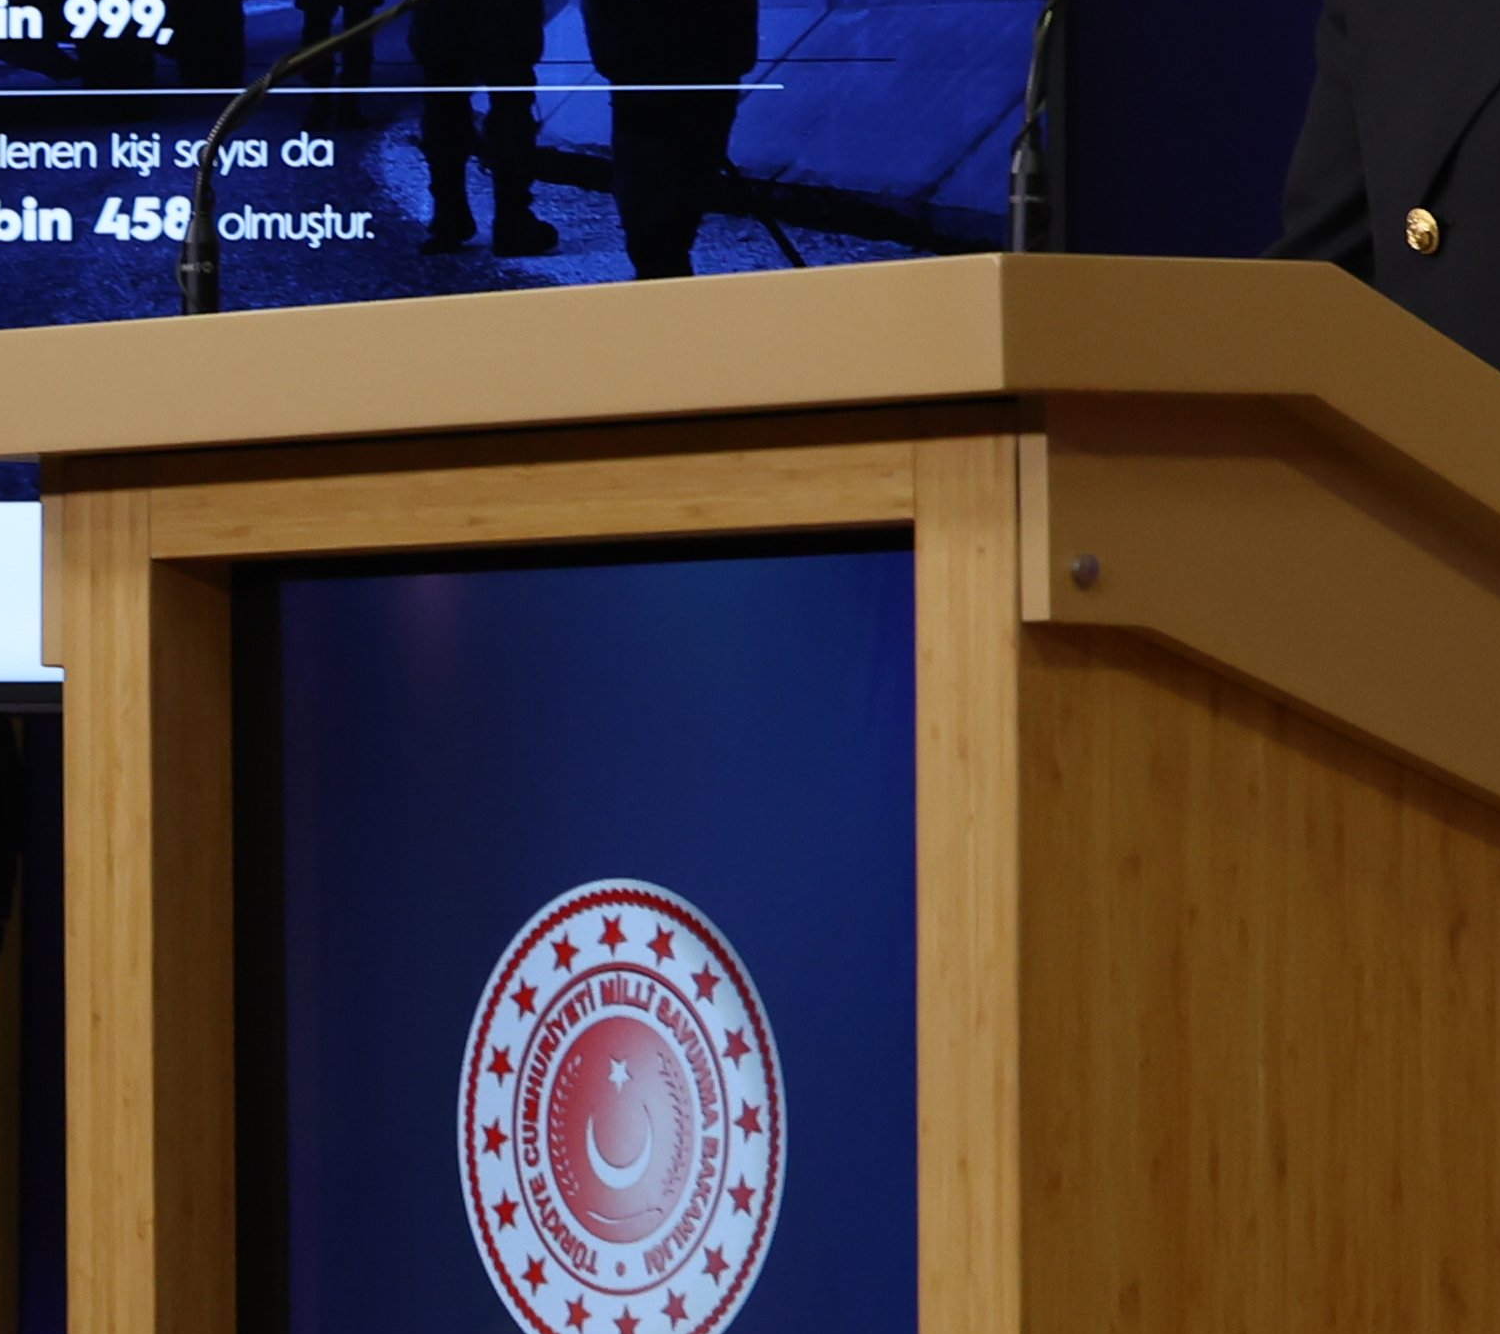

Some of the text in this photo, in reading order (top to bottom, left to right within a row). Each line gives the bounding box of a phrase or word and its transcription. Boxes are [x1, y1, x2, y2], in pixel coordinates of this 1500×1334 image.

[111, 132, 161, 178] kişi
[280, 130, 335, 168] da
[93, 195, 192, 242] 458
[217, 203, 376, 249] olmuştur.
